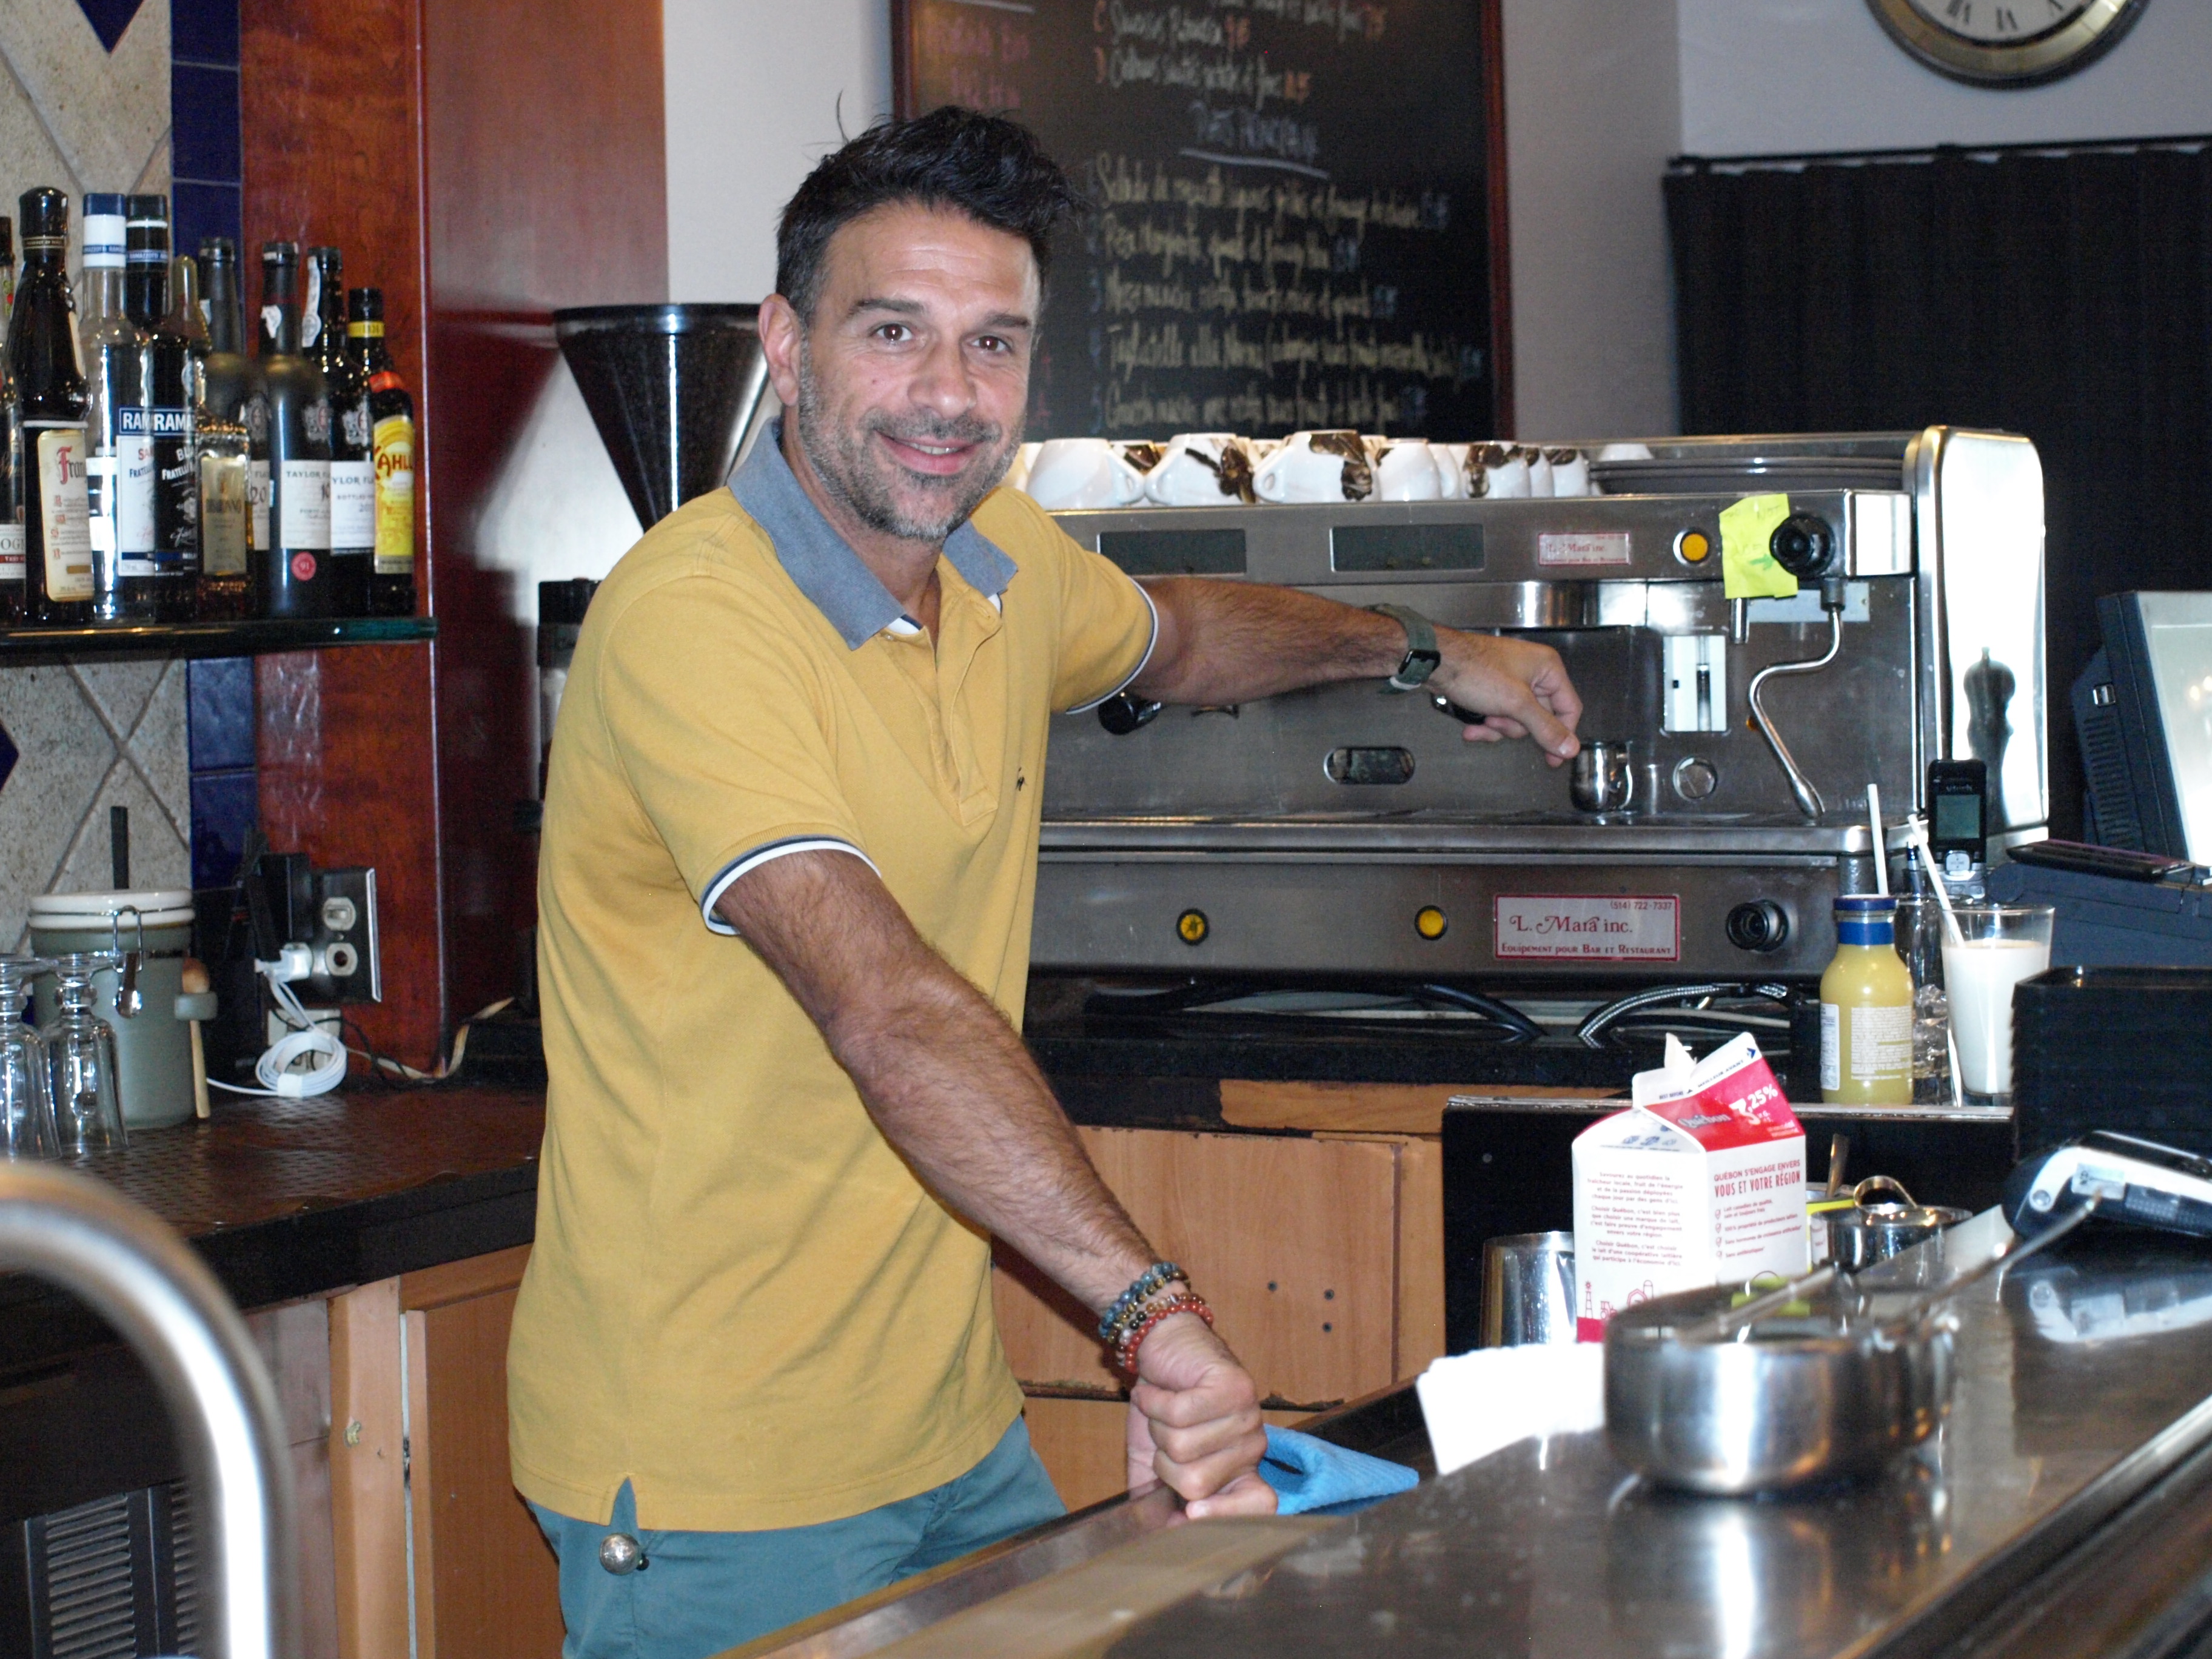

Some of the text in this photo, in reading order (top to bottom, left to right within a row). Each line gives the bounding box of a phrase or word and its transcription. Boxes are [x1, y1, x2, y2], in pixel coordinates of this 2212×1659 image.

[1603, 919, 1633, 933] inc.
[1728, 1084, 1778, 1125] 3,25%
[1714, 1159, 1800, 1182] QUÉBON S'ENGAGE ENVERS
[1714, 1170, 1801, 1198] VOUS ET VOTRE RÉGION
